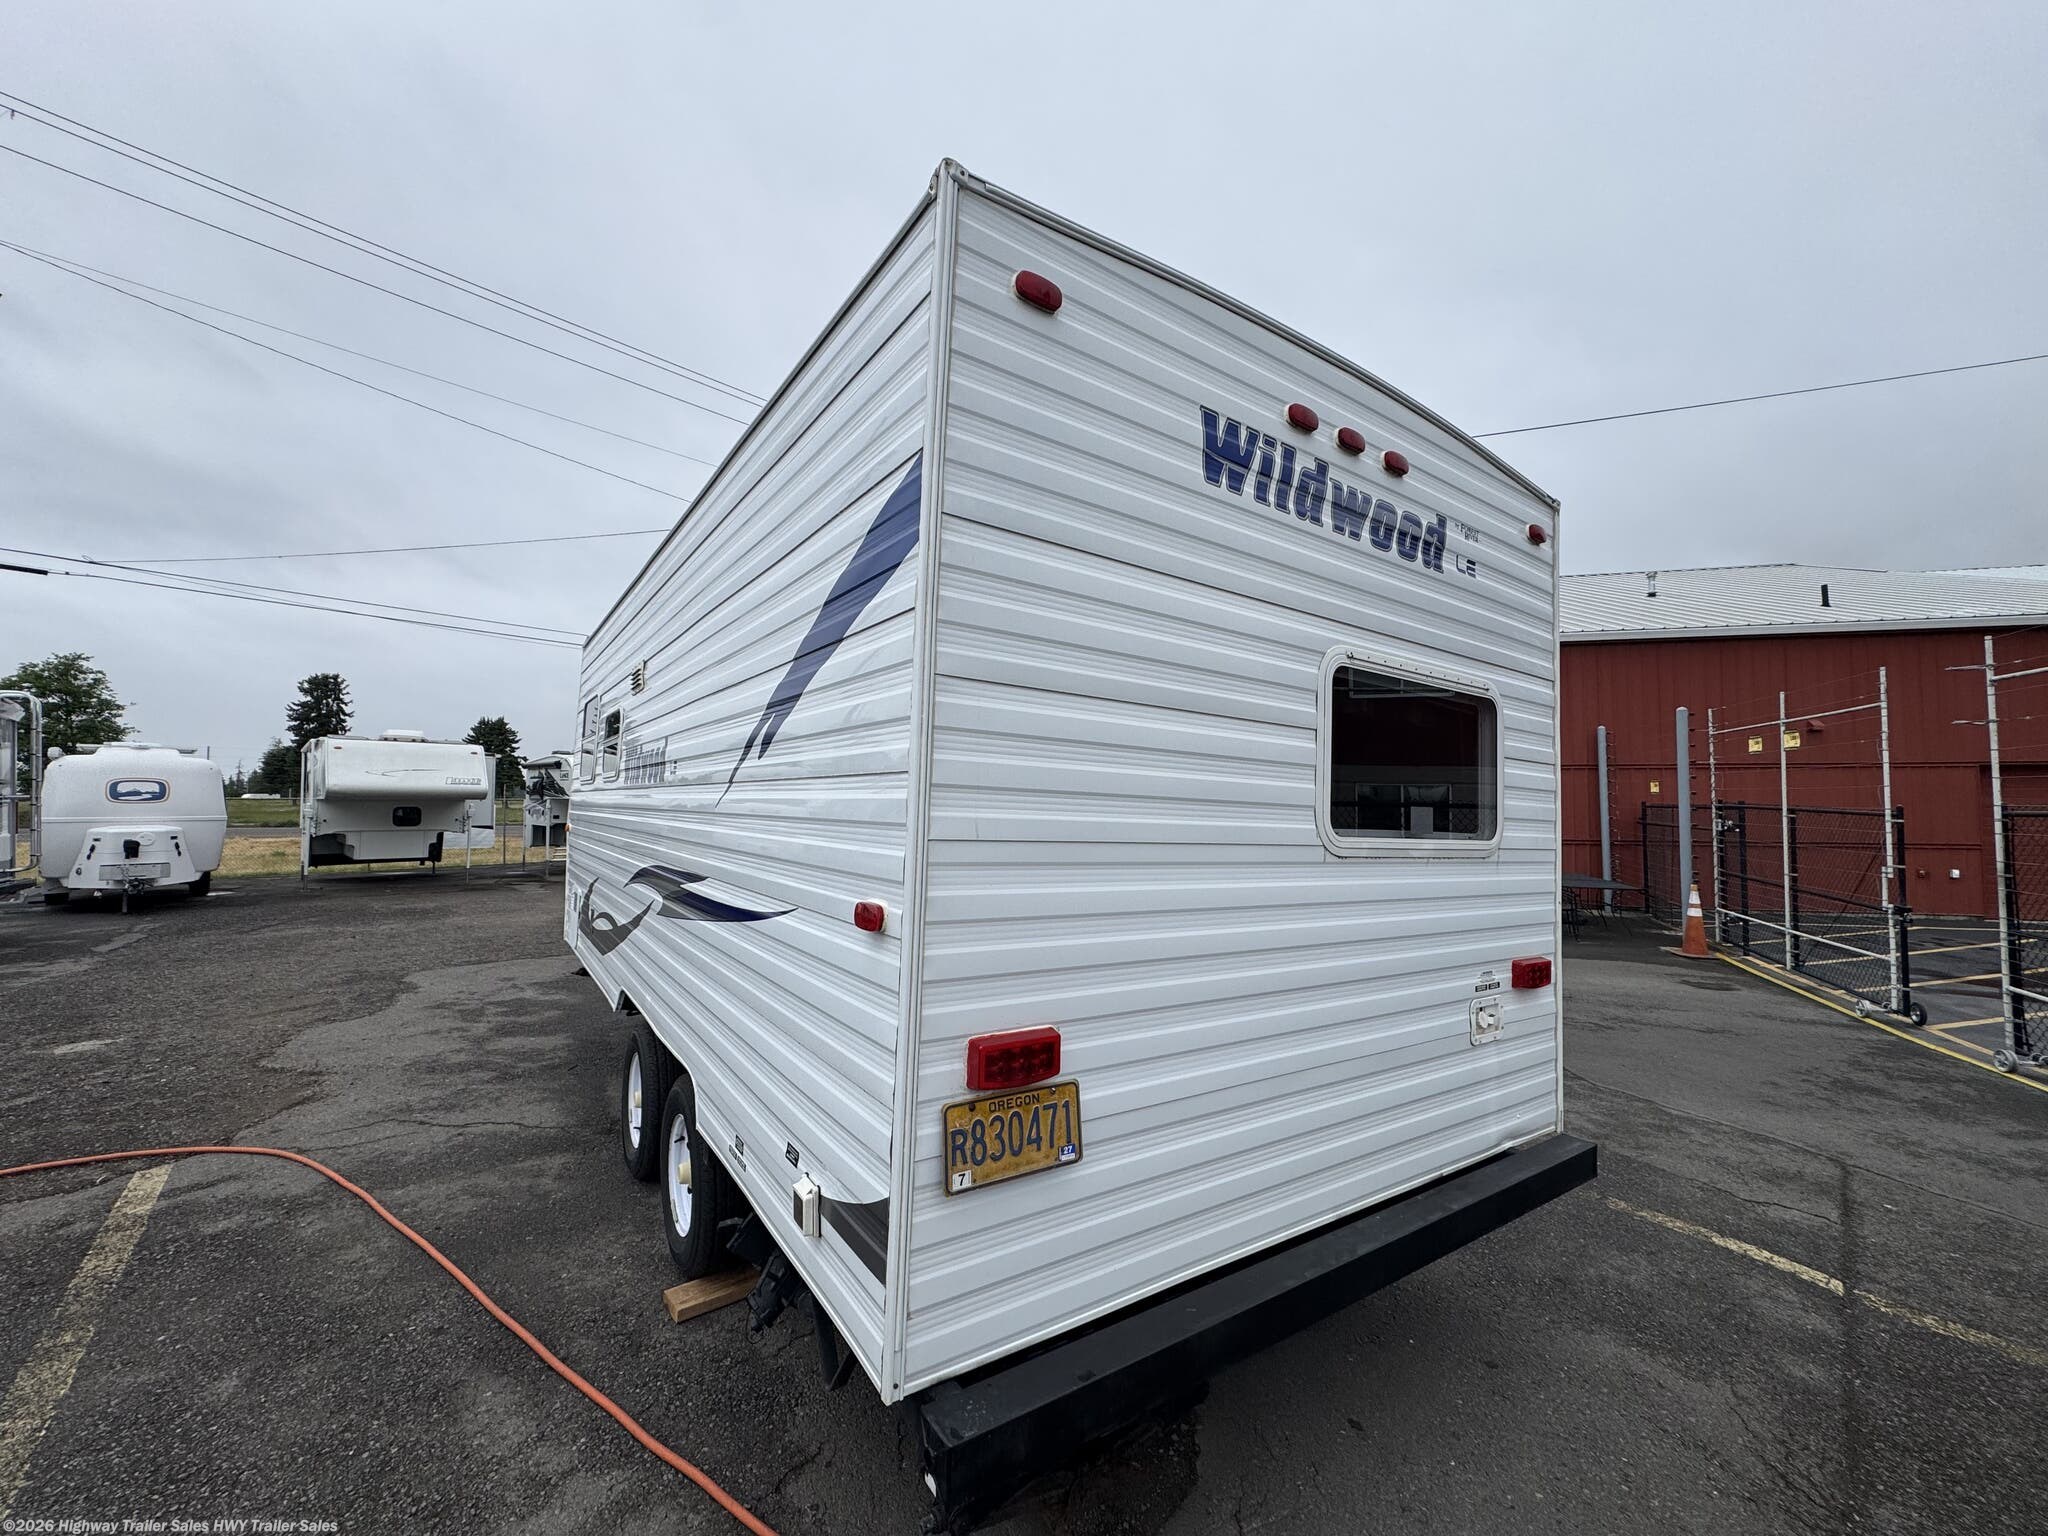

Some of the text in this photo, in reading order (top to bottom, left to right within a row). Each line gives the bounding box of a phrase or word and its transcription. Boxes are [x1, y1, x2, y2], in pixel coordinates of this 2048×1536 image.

[1200, 405, 1448, 575] Wildwood
[1456, 554, 1477, 579] LE
[988, 1092, 1040, 1113] OREGON
[950, 1099, 1073, 1168] R830471
[1063, 1145, 1073, 1154] 27
[958, 1173, 966, 1186] 7
